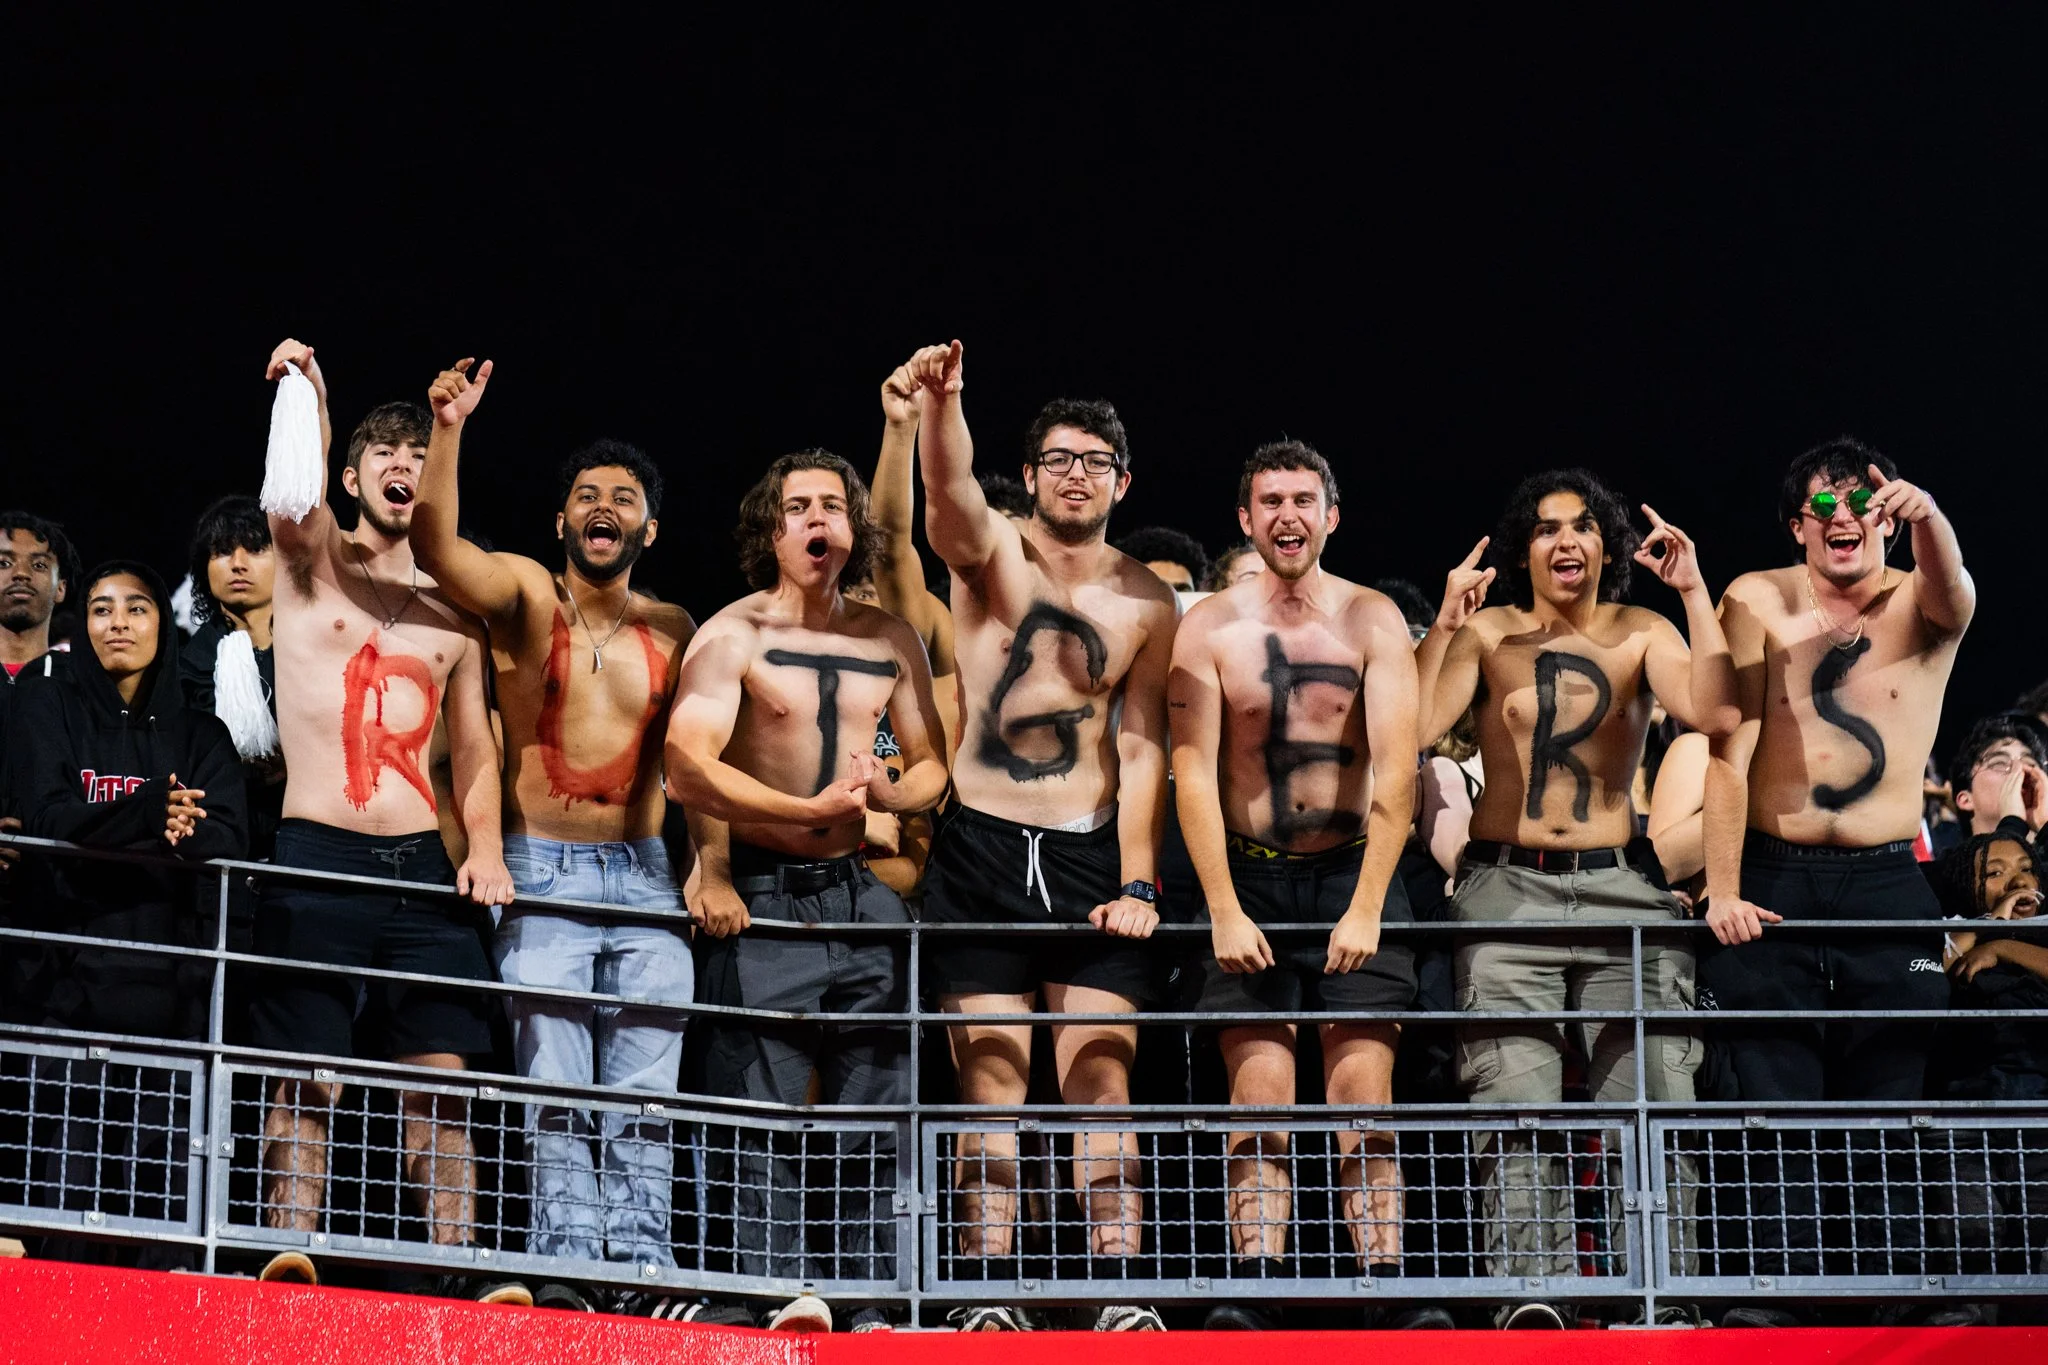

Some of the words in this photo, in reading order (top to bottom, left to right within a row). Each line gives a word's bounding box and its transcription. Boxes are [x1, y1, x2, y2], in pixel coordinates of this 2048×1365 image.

[342, 628, 439, 812] R
[536, 607, 668, 811] U
[764, 648, 898, 796] T
[977, 600, 1108, 783] G
[1260, 632, 1363, 846] E
[1526, 650, 1612, 822] R
[1811, 637, 1886, 811] S
